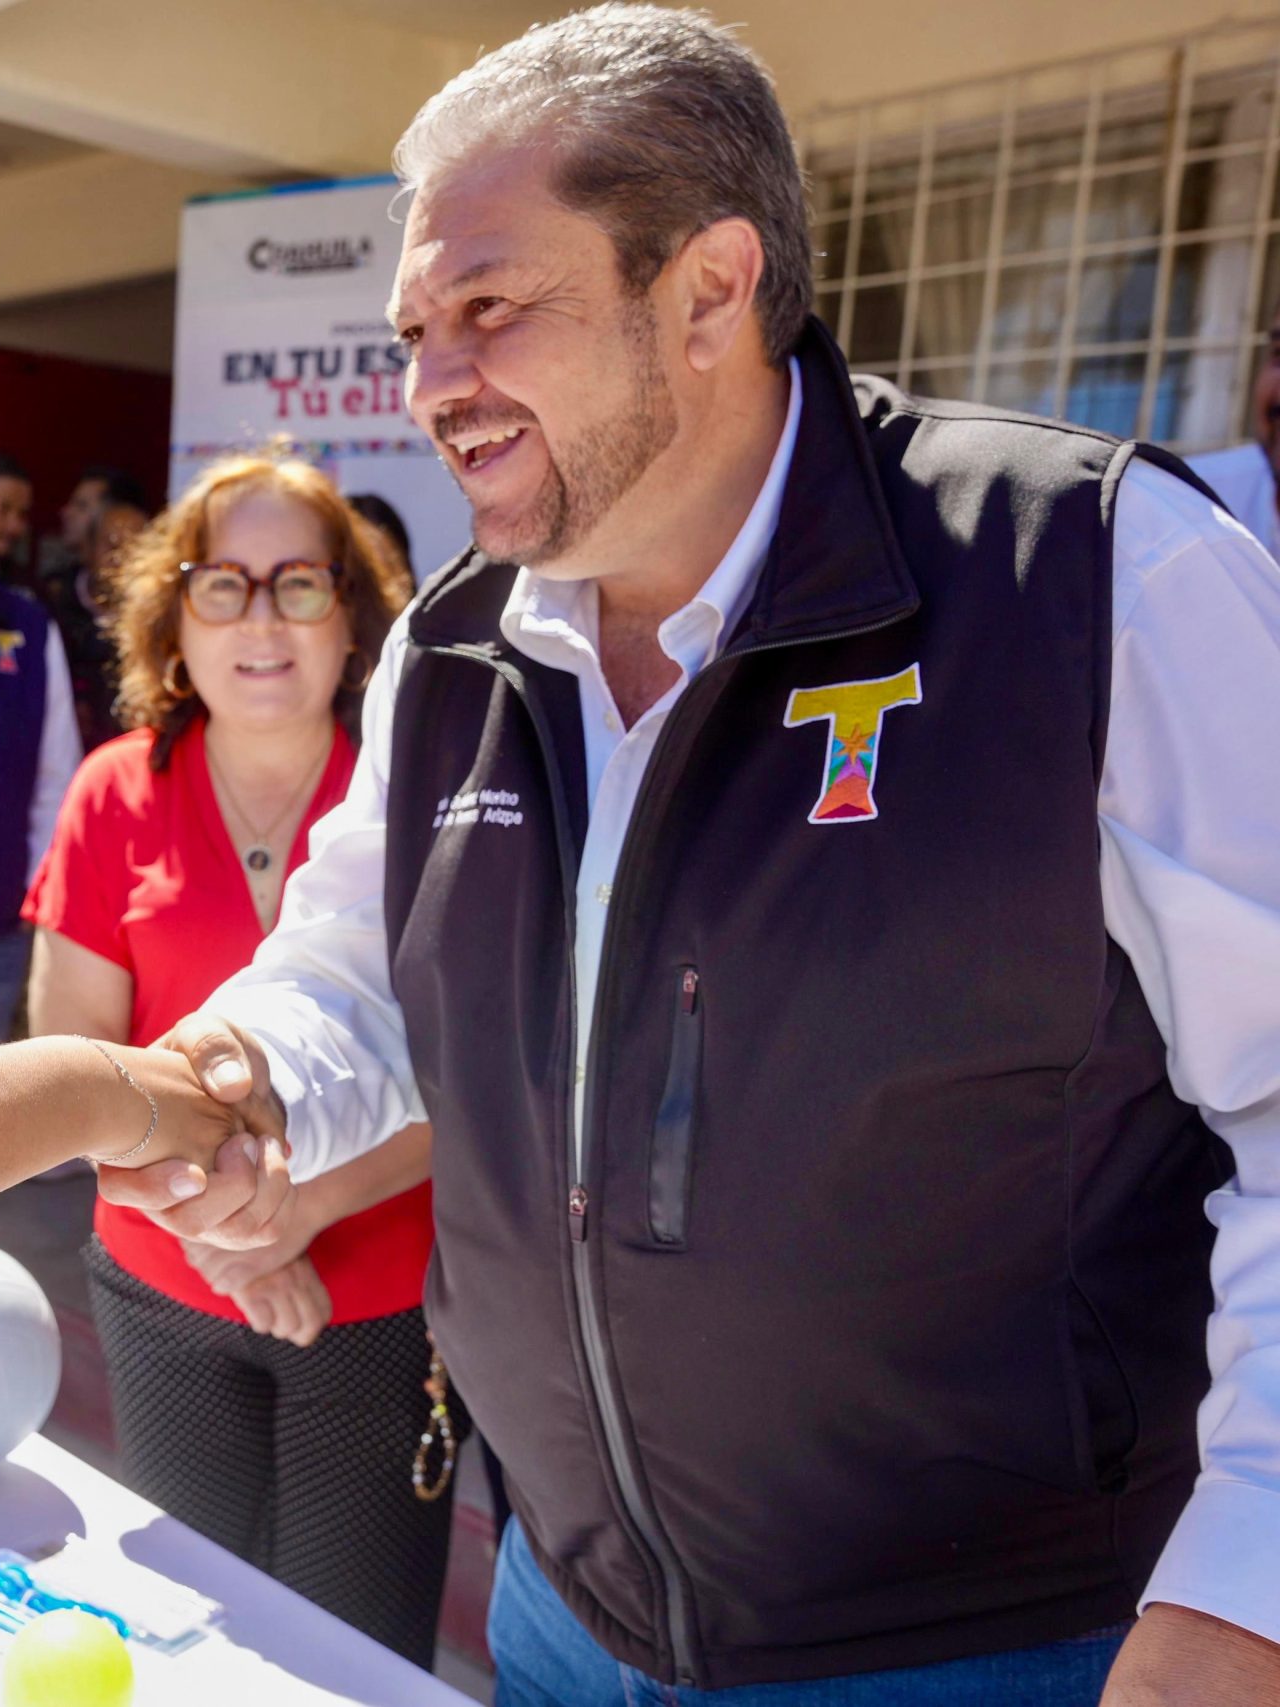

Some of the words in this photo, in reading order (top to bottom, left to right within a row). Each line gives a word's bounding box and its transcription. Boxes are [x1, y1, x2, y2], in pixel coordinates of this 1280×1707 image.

[224, 351, 276, 383] EN
[288, 346, 343, 379] TU
[355, 343, 410, 377] ES
[341, 371, 414, 424] eli
[783, 661, 923, 825] T
